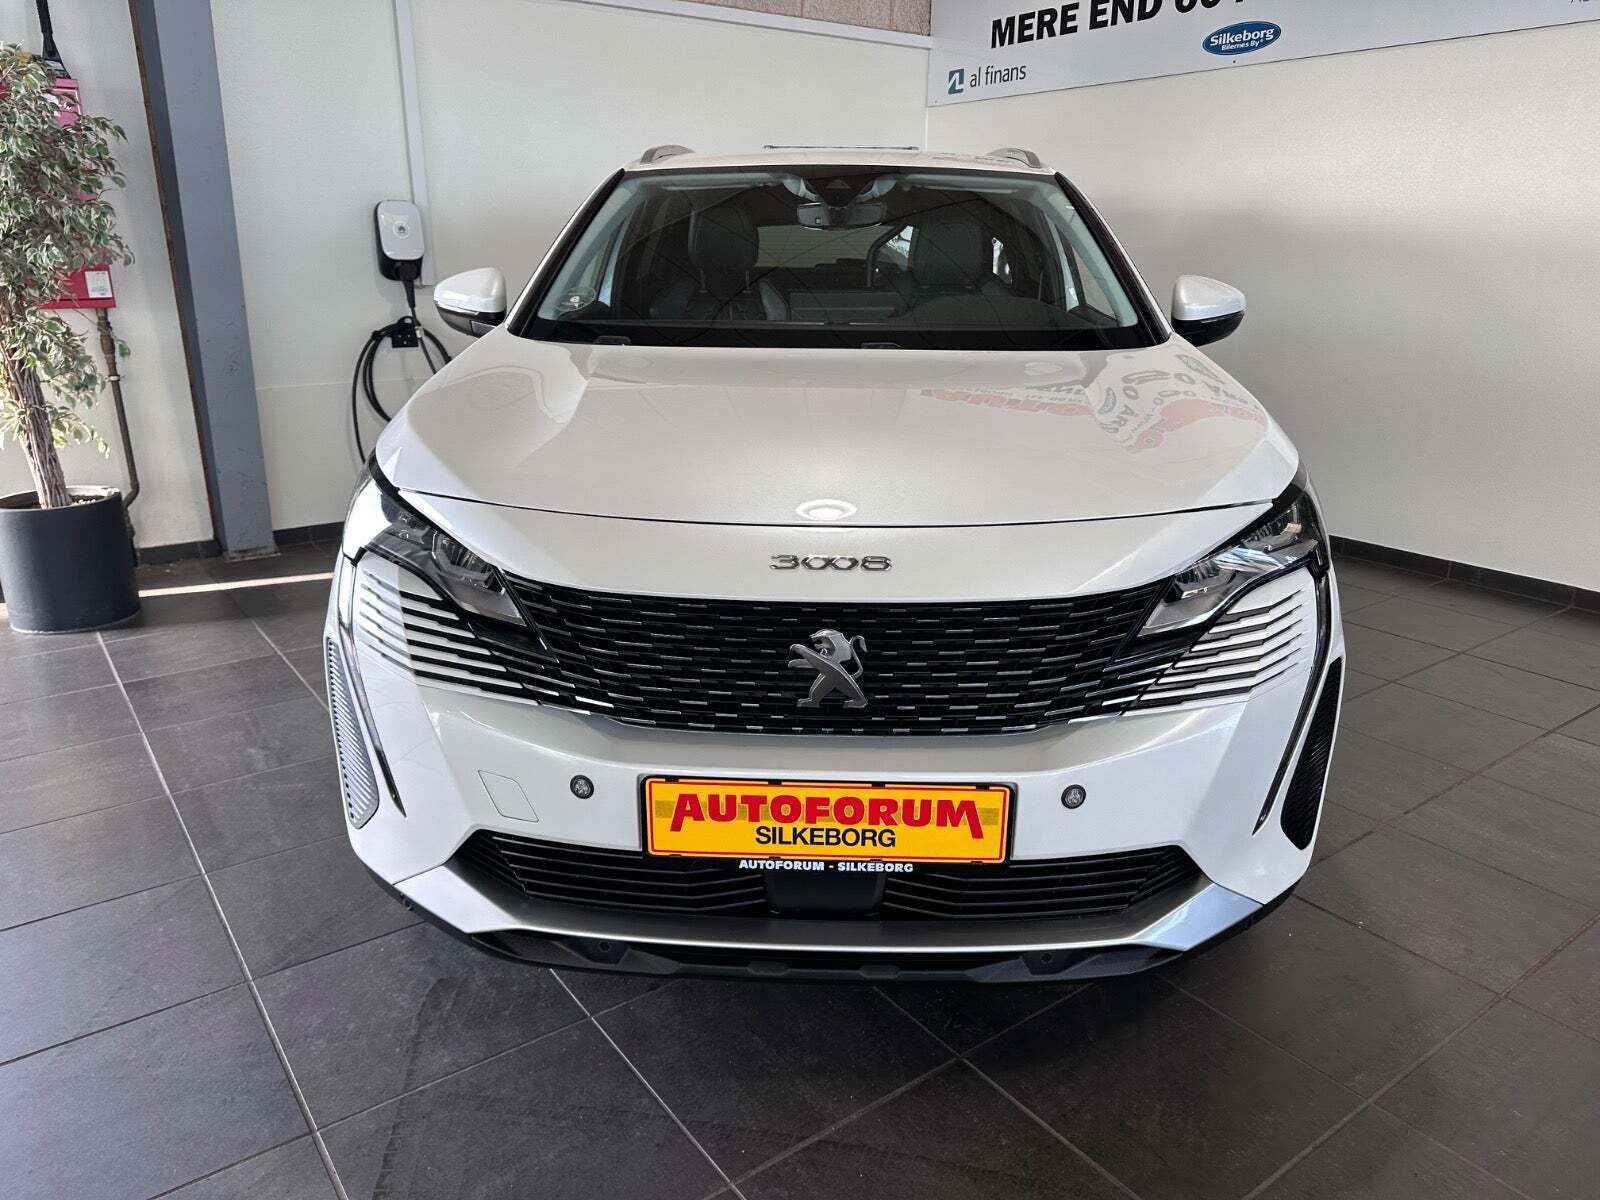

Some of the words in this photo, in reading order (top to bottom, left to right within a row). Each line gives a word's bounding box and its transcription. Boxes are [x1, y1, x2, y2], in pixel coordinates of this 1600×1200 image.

[991, 2, 1080, 49] MERE
[1089, 0, 1162, 30] END
[1210, 28, 1275, 46] Silkeborg
[970, 66, 981, 88] al
[985, 65, 1027, 86] finans
[769, 554, 893, 571] 3008
[669, 793, 984, 840] AUTOFORUM
[755, 825, 896, 848] SILKEBORG
[738, 859, 825, 871] AUTOFORUM
[837, 861, 914, 873] SILKEBORG
